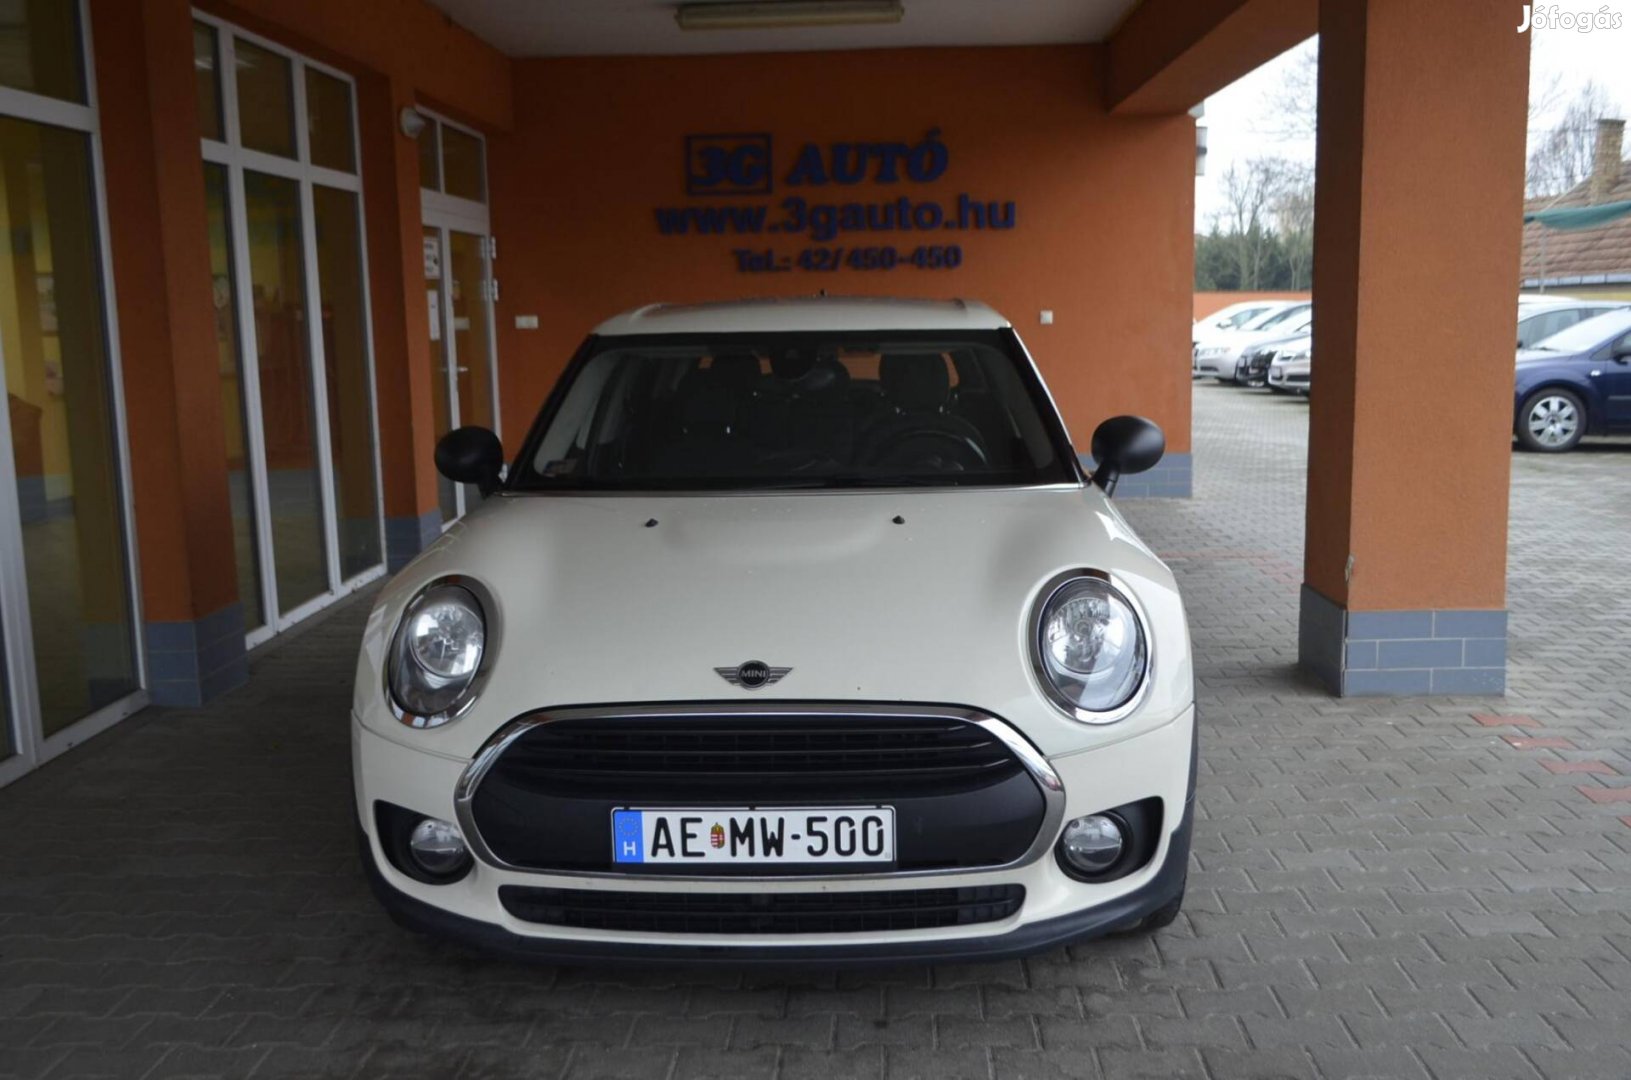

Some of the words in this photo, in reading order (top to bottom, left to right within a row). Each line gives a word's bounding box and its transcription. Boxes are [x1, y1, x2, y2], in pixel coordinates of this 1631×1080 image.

[691, 144, 766, 187] 3G
[787, 127, 948, 186] AUTÓ
[655, 194, 1015, 241] www.3gauto.hu
[741, 669, 766, 678] MINI
[624, 841, 636, 856] H
[651, 817, 706, 858] AE
[729, 816, 884, 857] MW-500
